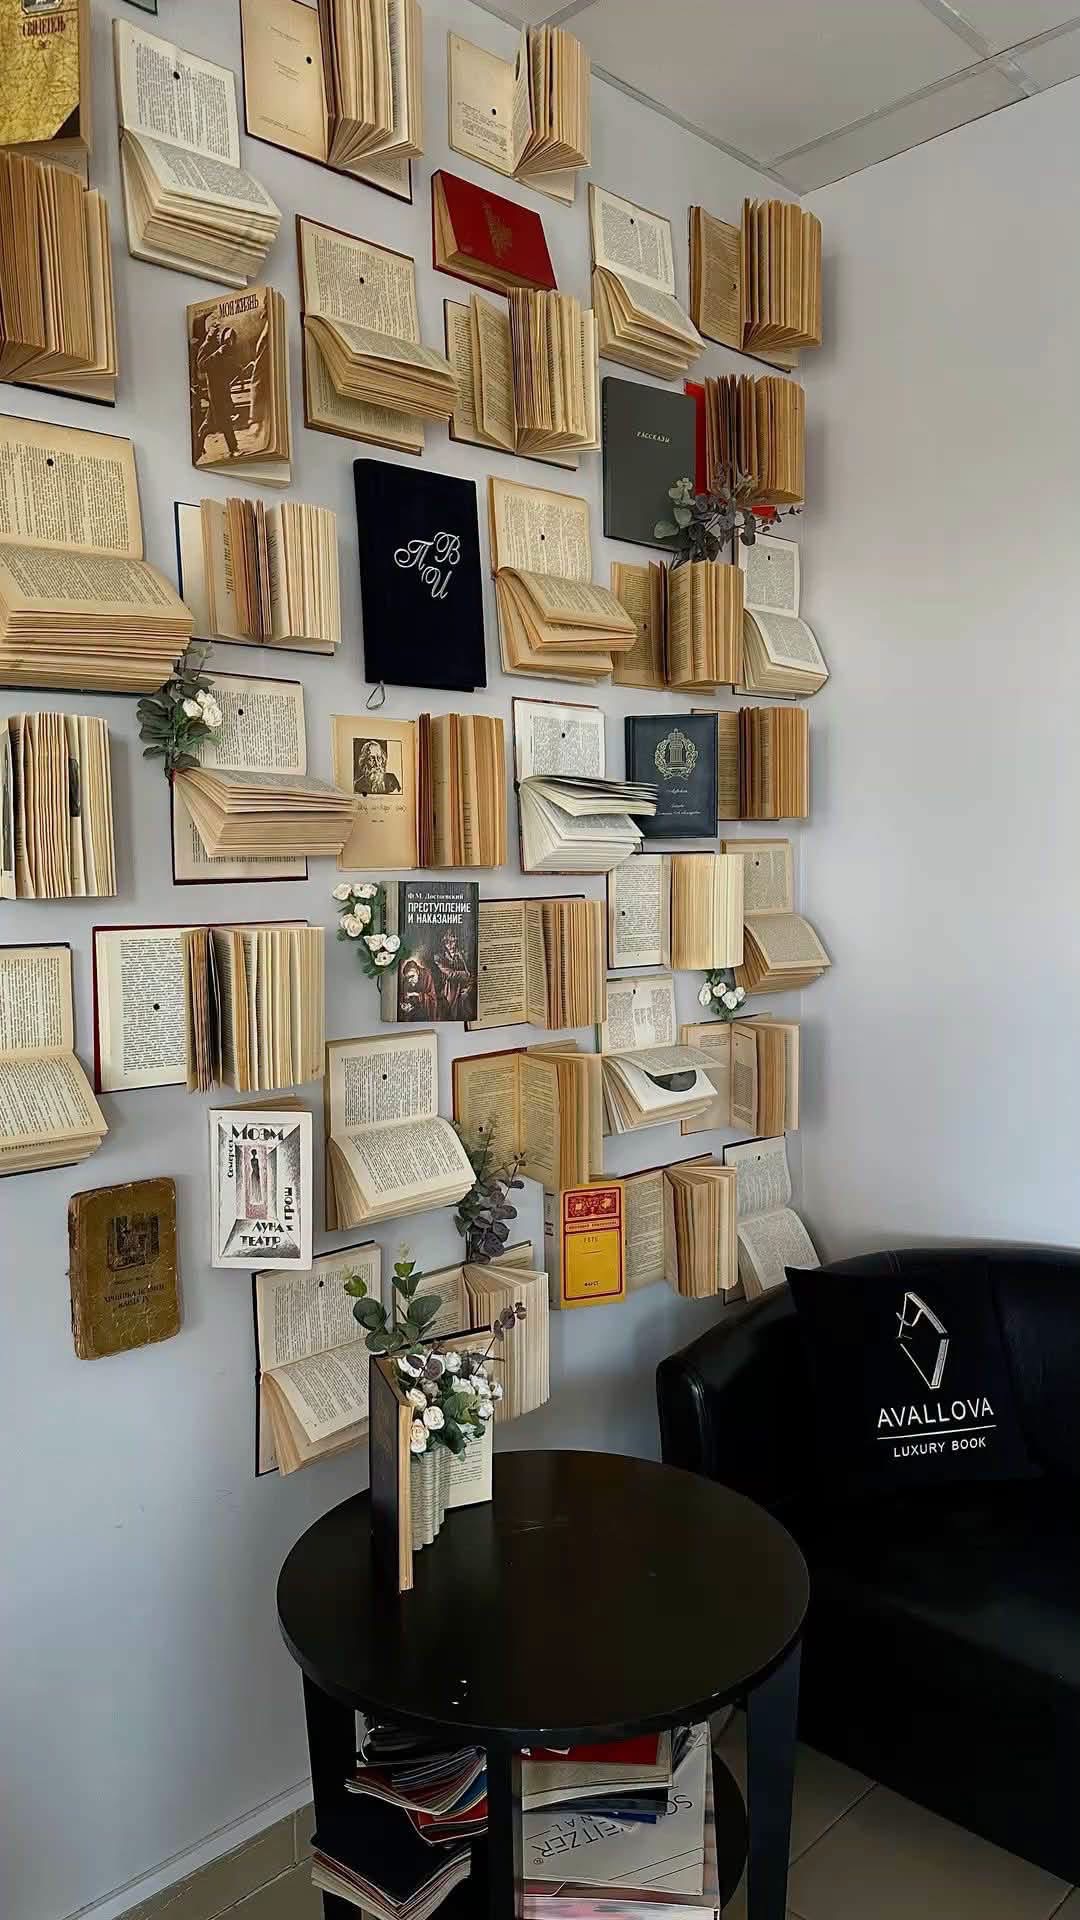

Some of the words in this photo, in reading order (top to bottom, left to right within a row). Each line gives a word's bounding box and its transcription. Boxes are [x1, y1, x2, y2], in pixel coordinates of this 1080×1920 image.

[219, 302, 235, 318] МОЯ
[235, 294, 259, 315] ЖИЗНЬ
[407, 902, 471, 913] ПРЕСТУПЛЕНИЕ
[407, 914, 414, 924] И
[416, 914, 463, 924] НАКАЗАНИЕ
[252, 1221, 284, 1234] ЛУНА
[239, 1235, 281, 1249] ТЕАТР
[877, 1397, 995, 1428] AVALLOVA
[893, 1442, 945, 1458] LUXURY
[951, 1436, 986, 1451] BOOK
